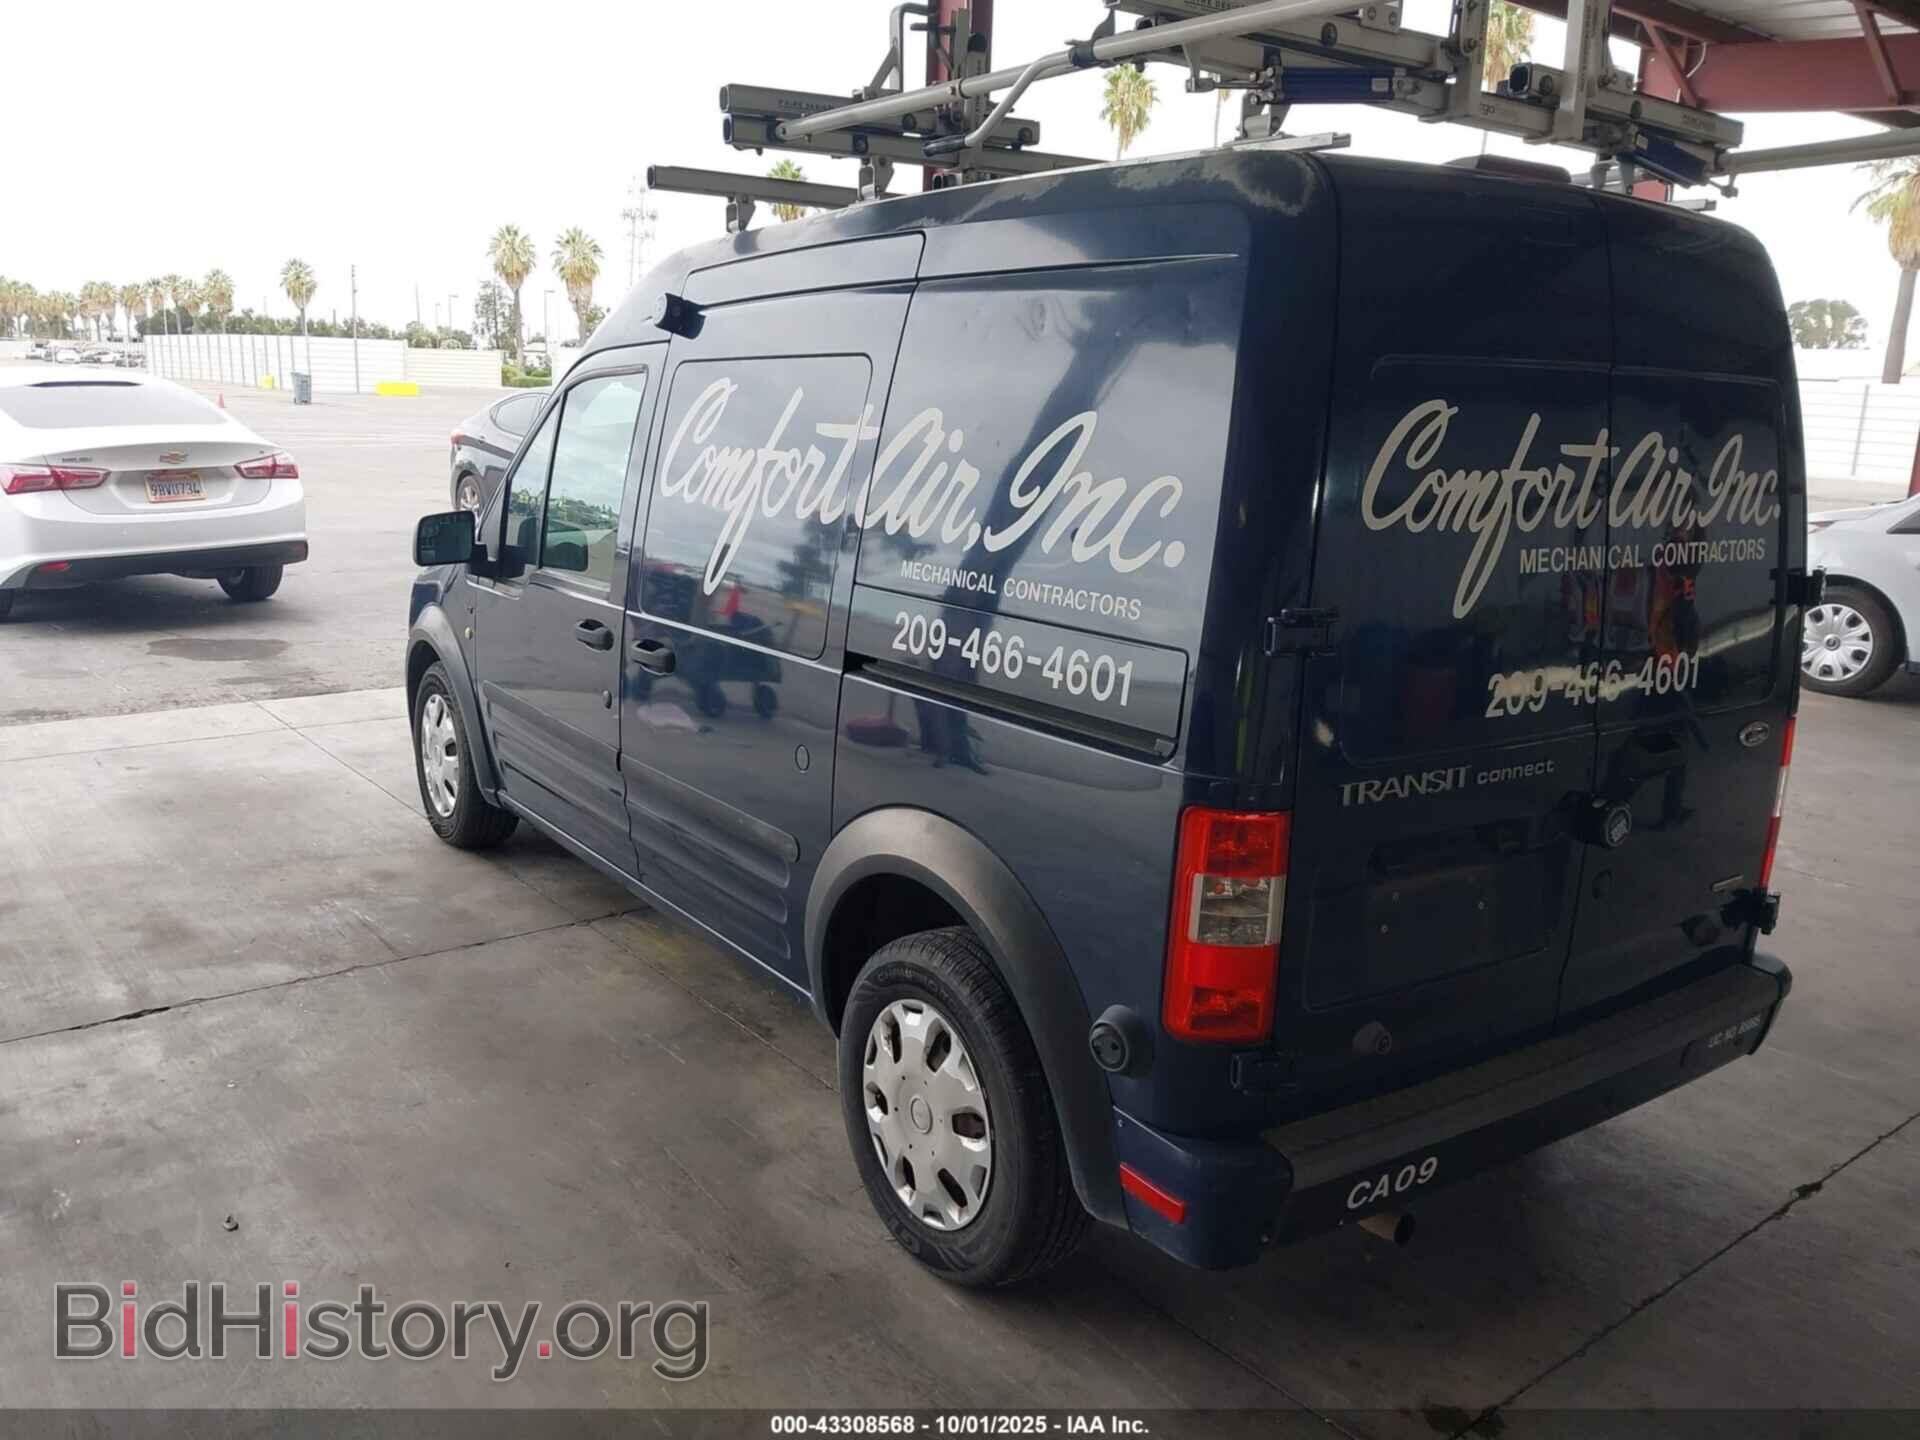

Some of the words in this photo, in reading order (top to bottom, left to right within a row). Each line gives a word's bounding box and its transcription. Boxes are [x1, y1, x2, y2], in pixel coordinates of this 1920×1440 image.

[660, 376, 880, 596] Comfort
[856, 407, 984, 553] Air,
[984, 411, 1187, 574] Inc.
[1361, 399, 1620, 620] Comfort
[1608, 431, 1698, 531] Air,
[1696, 434, 1782, 527] Inc.
[1519, 544, 1645, 574] MECHANICAL
[1650, 538, 1766, 567] CONTRACTORS
[899, 560, 998, 596] MECHANICAL
[1003, 577, 1143, 621] CONTRACTORS
[891, 611, 1136, 708] 209-466-4601
[1484, 651, 1702, 719] 209-466-4601
[1340, 765, 1472, 808] TRANSIT
[1476, 759, 1556, 786] connect
